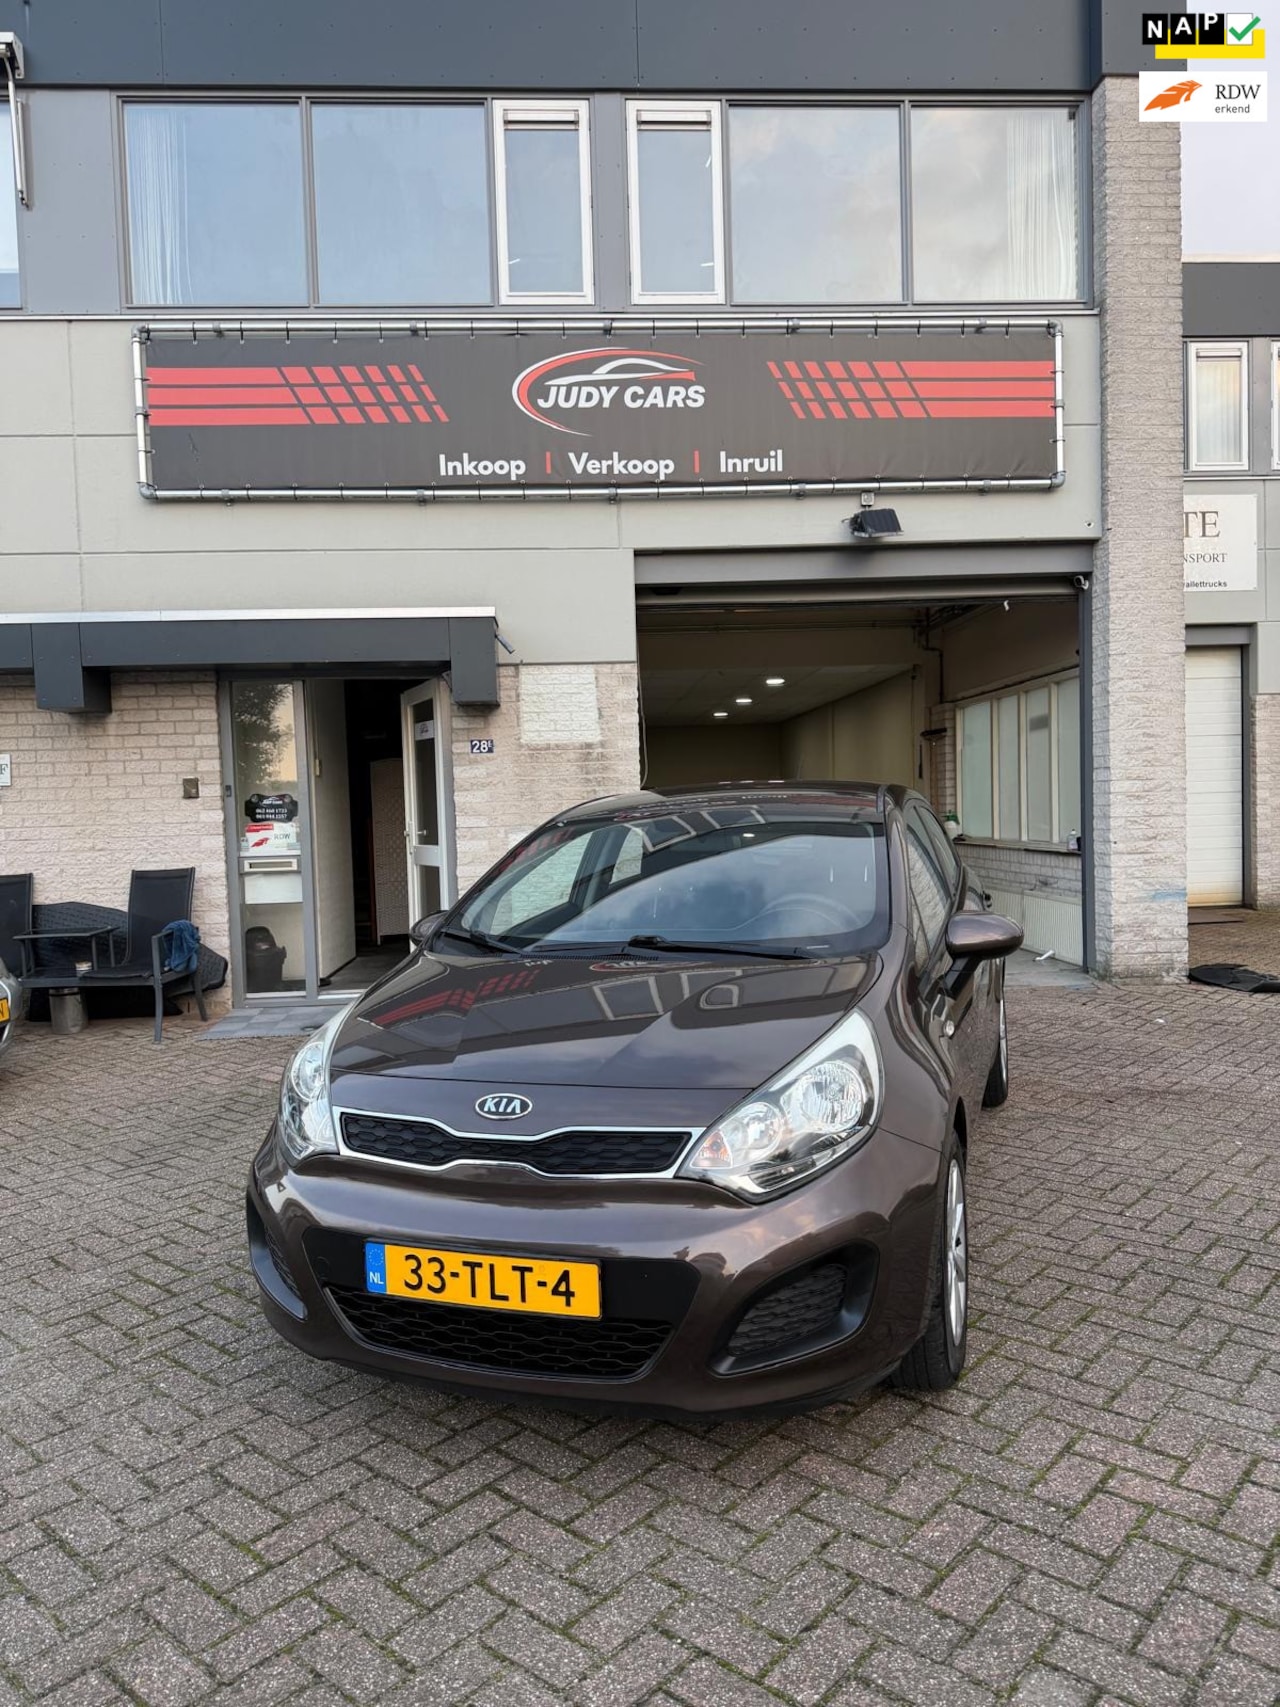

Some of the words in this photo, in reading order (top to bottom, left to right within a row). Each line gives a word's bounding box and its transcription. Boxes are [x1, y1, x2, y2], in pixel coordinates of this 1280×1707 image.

[537, 385, 619, 408] JUDY
[623, 385, 706, 408] CARS
[439, 453, 526, 480] Inkoop
[568, 451, 675, 480] Verkoop
[720, 449, 783, 473] Inruil
[1183, 580, 1227, 588] allettrucks
[483, 1098, 521, 1114] KIA
[369, 1272, 384, 1285] NL
[404, 1254, 575, 1307] 33-TLT-4
